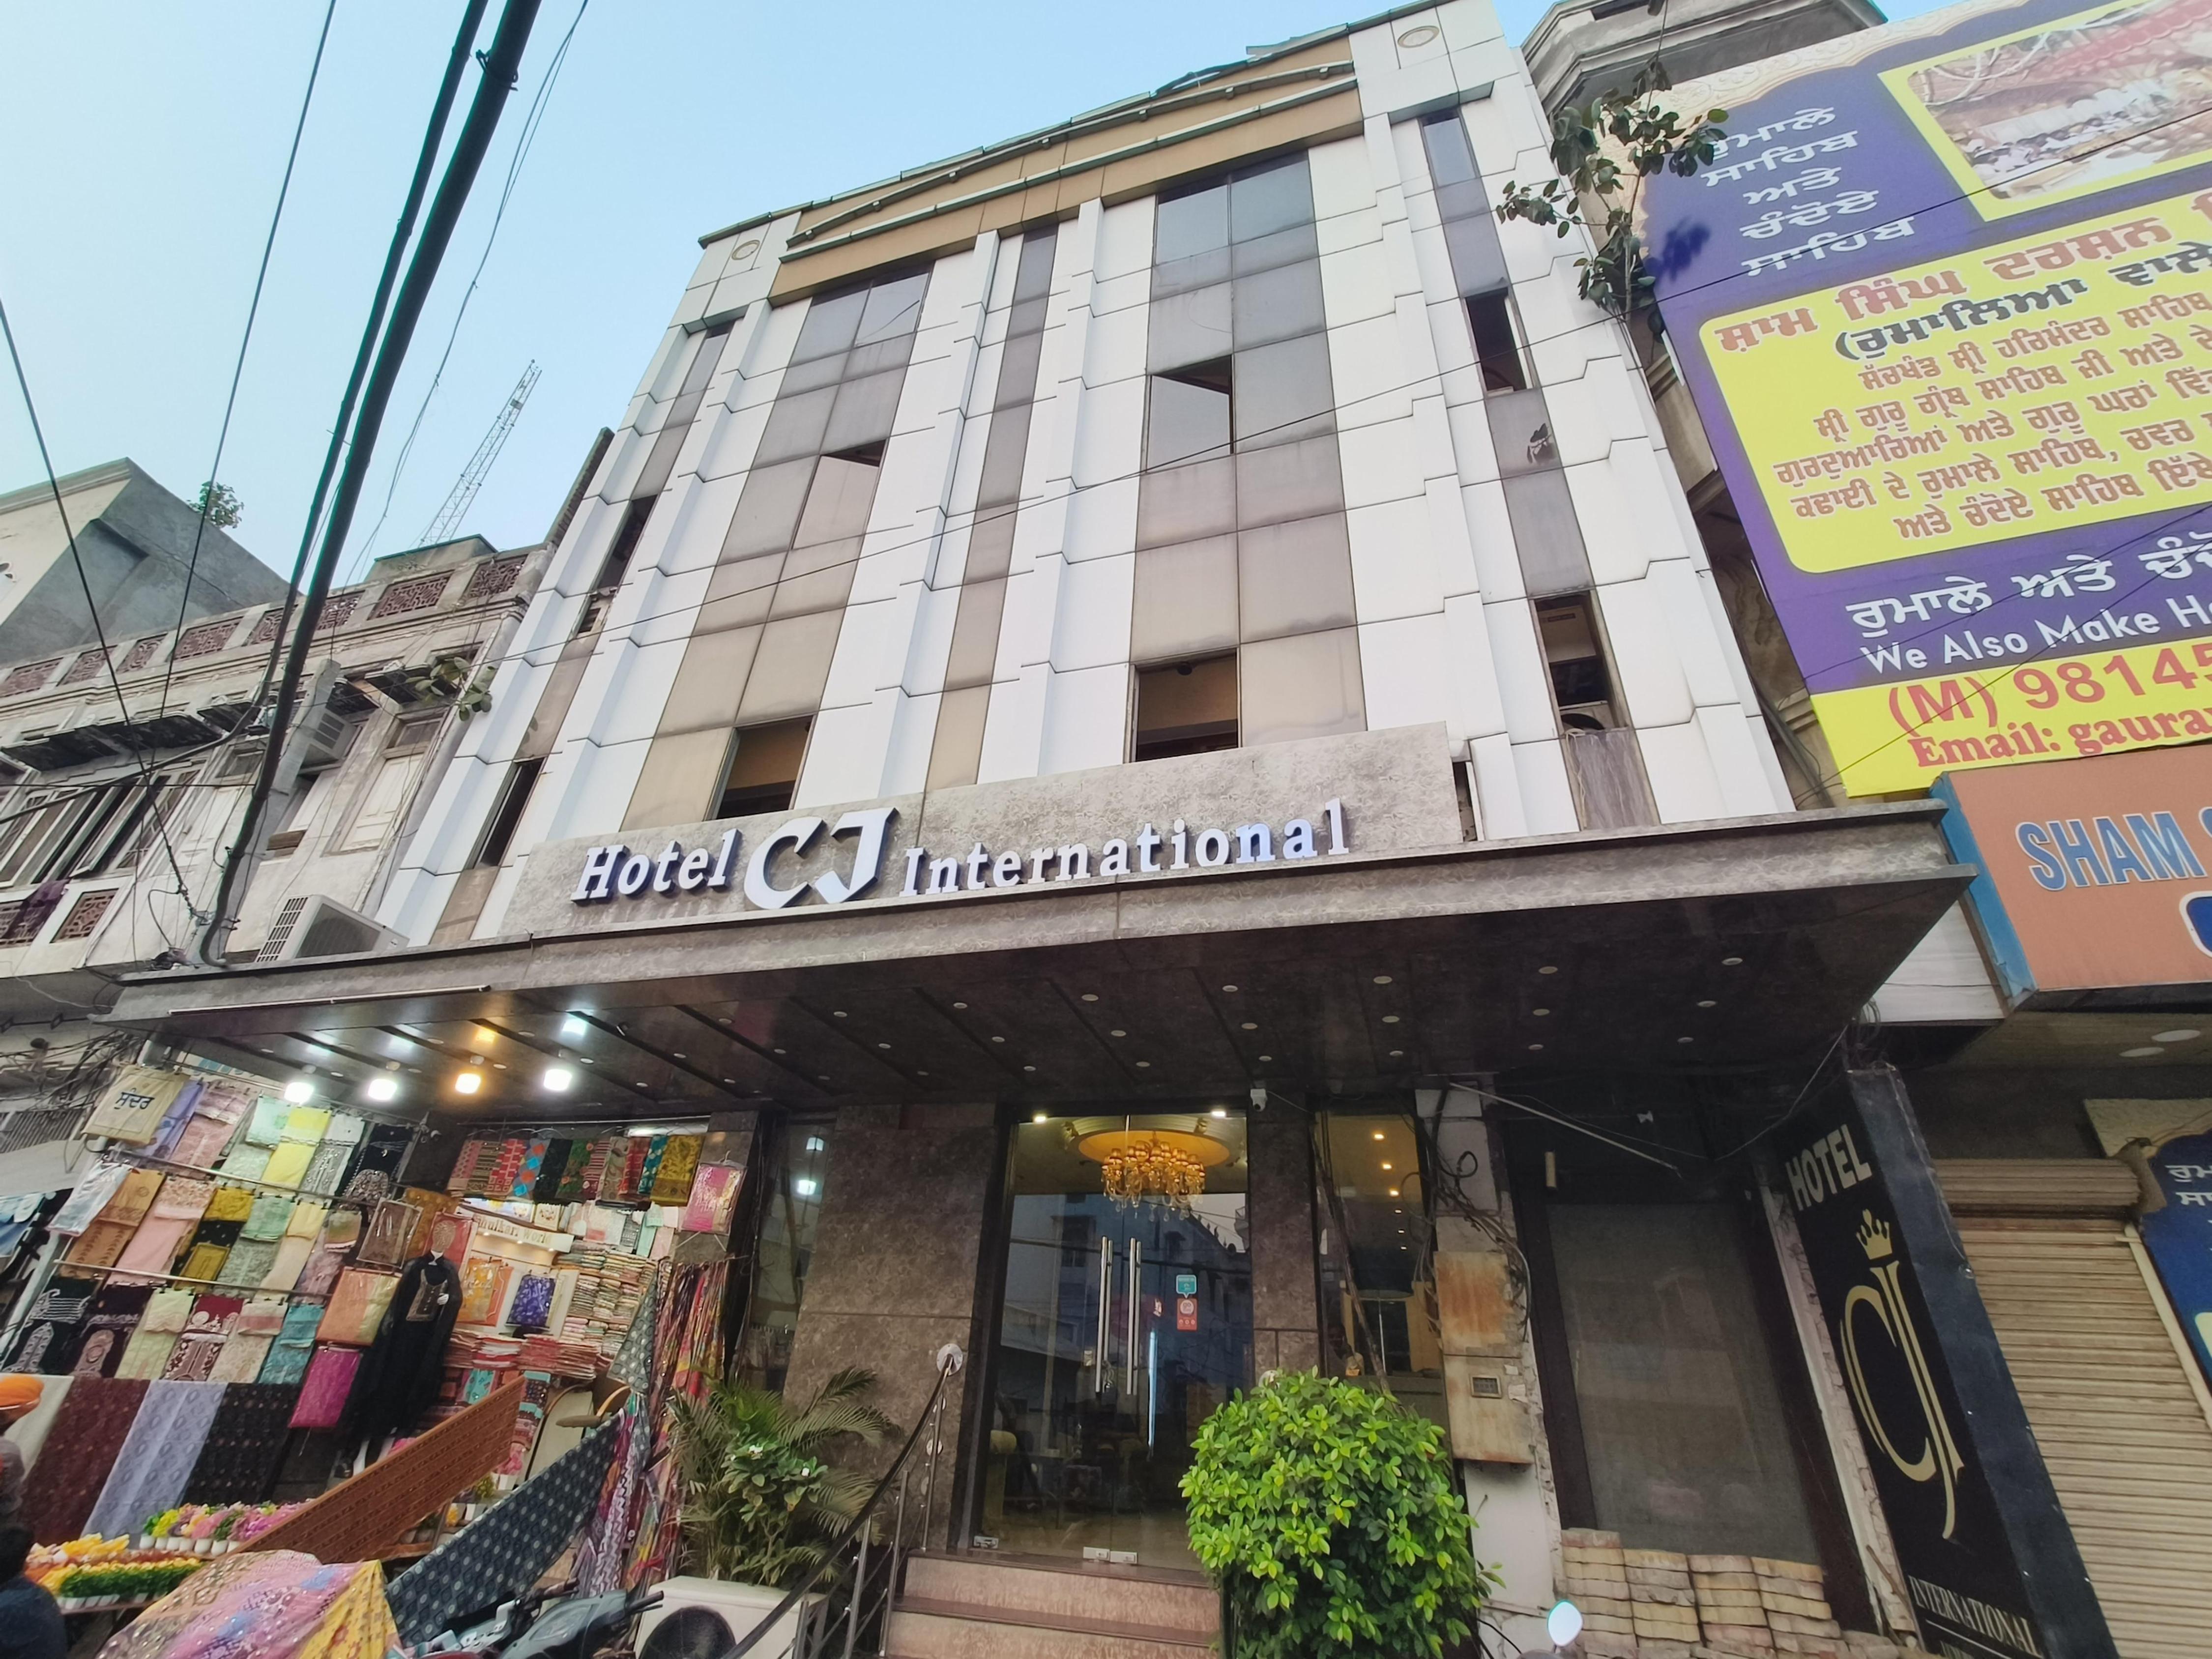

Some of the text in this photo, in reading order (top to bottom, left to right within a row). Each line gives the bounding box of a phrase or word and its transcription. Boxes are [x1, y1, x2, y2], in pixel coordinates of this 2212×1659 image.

[1700, 130, 1858, 187] ਸਾਹਿਬ
[1743, 167, 1842, 204] ਅਤੇ
[1714, 217, 2172, 352] ਸ਼ਾਮ ਸਿੰਘ ਦਰਸ਼ਨ
[1741, 216, 1915, 276] ਸਾਹਿਬ
[1858, 355, 1941, 390] ਸੱਚਖੰਡ
[1992, 316, 2111, 358] ਹਰਿਮੰਦਰ
[2117, 292, 2212, 328] ਸਾਹਿਬ
[1855, 401, 1908, 432] ਗੁਰੂ
[1975, 365, 2067, 400] ਸਾਹਿਬ
[2070, 349, 2115, 378] ਜੀ
[2119, 333, 2183, 366] ਅਤੇ
[1956, 409, 2015, 442] ਅਤੇ
[2021, 401, 2085, 435] ਗੁਰੂ
[2086, 379, 2157, 411] ਘਰਾਂ
[1883, 471, 1910, 499] ਦੇ
[1917, 453, 2001, 499] ਰੁਮਾਲੇ
[1892, 503, 1951, 538] ਅਤੇ
[2040, 473, 2145, 511] ਸਾਹਿਬ
[1845, 576, 1993, 638] ਰੁਮਾਲੇ
[2010, 554, 2116, 599] ਅਤੇ
[1859, 594, 2212, 674] We Also Make H
[1888, 676, 1998, 737] (M)
[1907, 721, 2062, 768] Email:
[571, 797, 1349, 909] Hotel CJ International
[2015, 811, 2208, 892] SHAM
[1785, 1123, 1873, 1212] HOTEL
[1907, 1574, 2044, 1659] INTERNATIONAL
